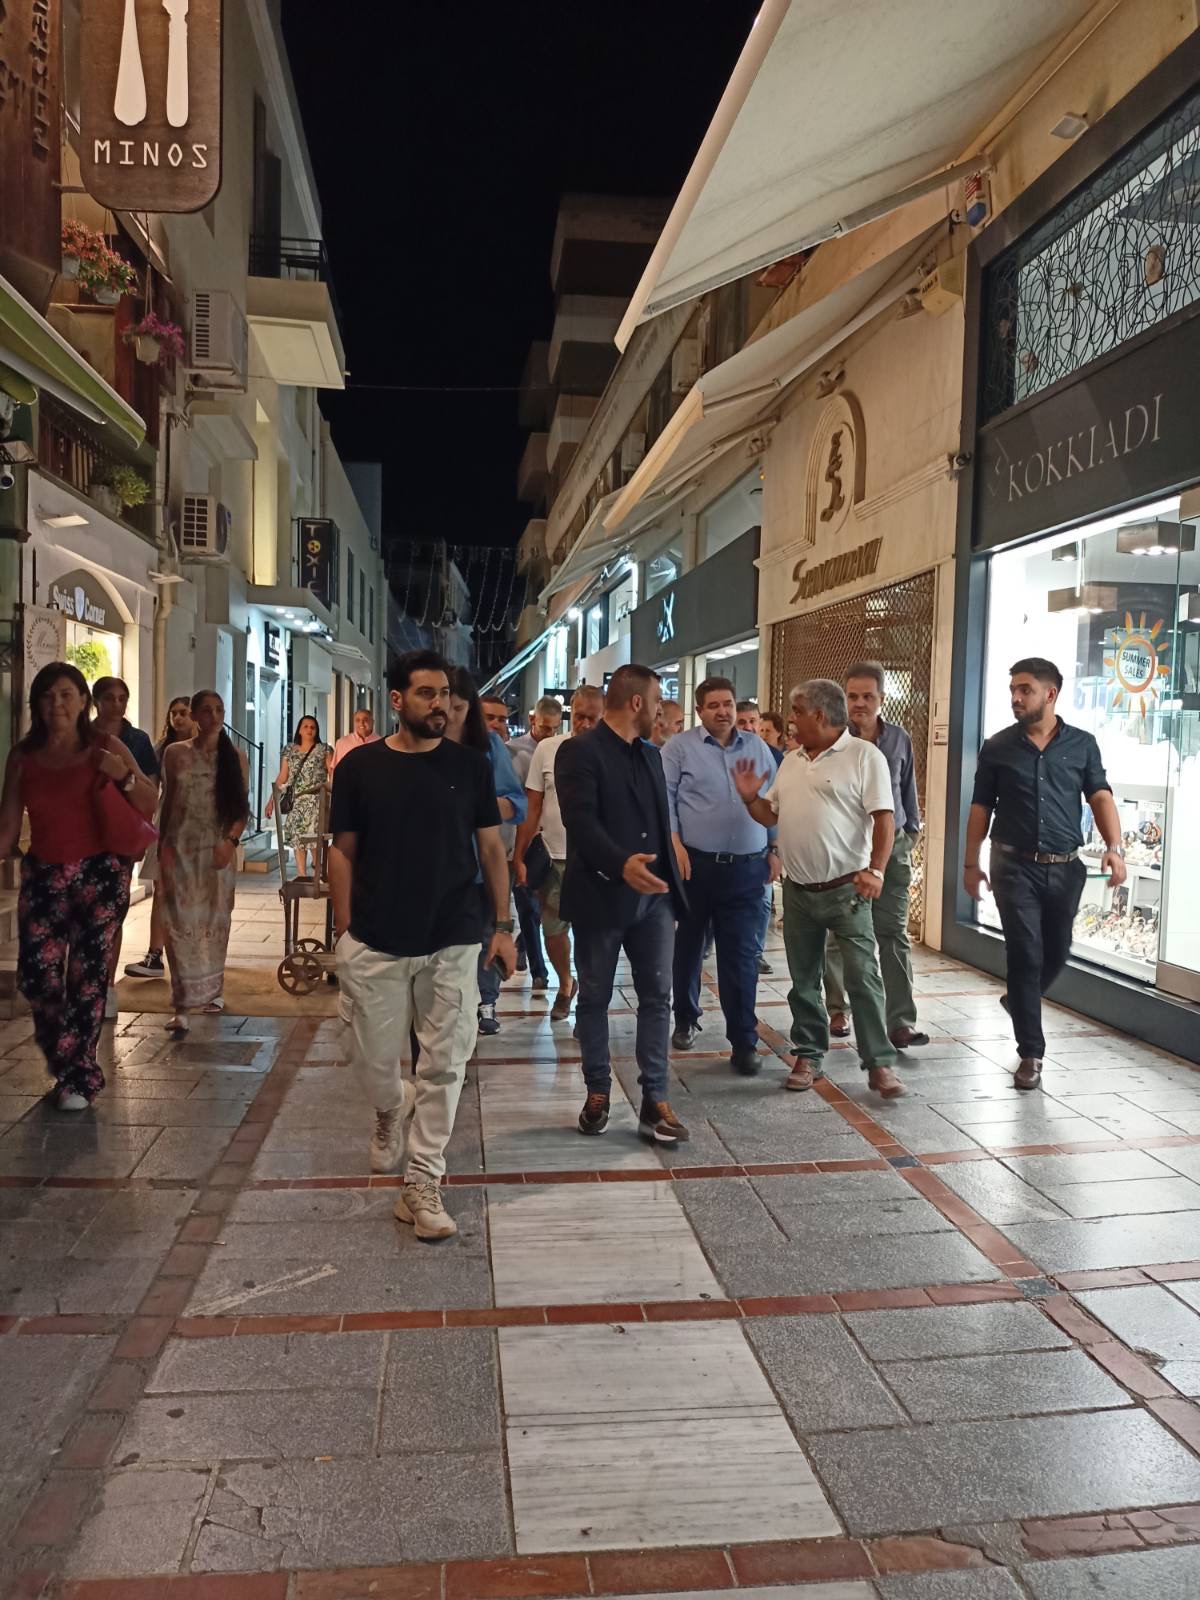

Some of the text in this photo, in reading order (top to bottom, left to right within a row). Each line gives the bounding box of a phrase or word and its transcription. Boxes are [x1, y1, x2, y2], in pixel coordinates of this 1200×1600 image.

[94, 138, 208, 169] MINOS
[1008, 395, 1163, 502] KOKKIADI
[53, 585, 106, 626] Swiss Corner
[1122, 652, 1151, 668] SUMMER
[1124, 665, 1145, 679] SALES
